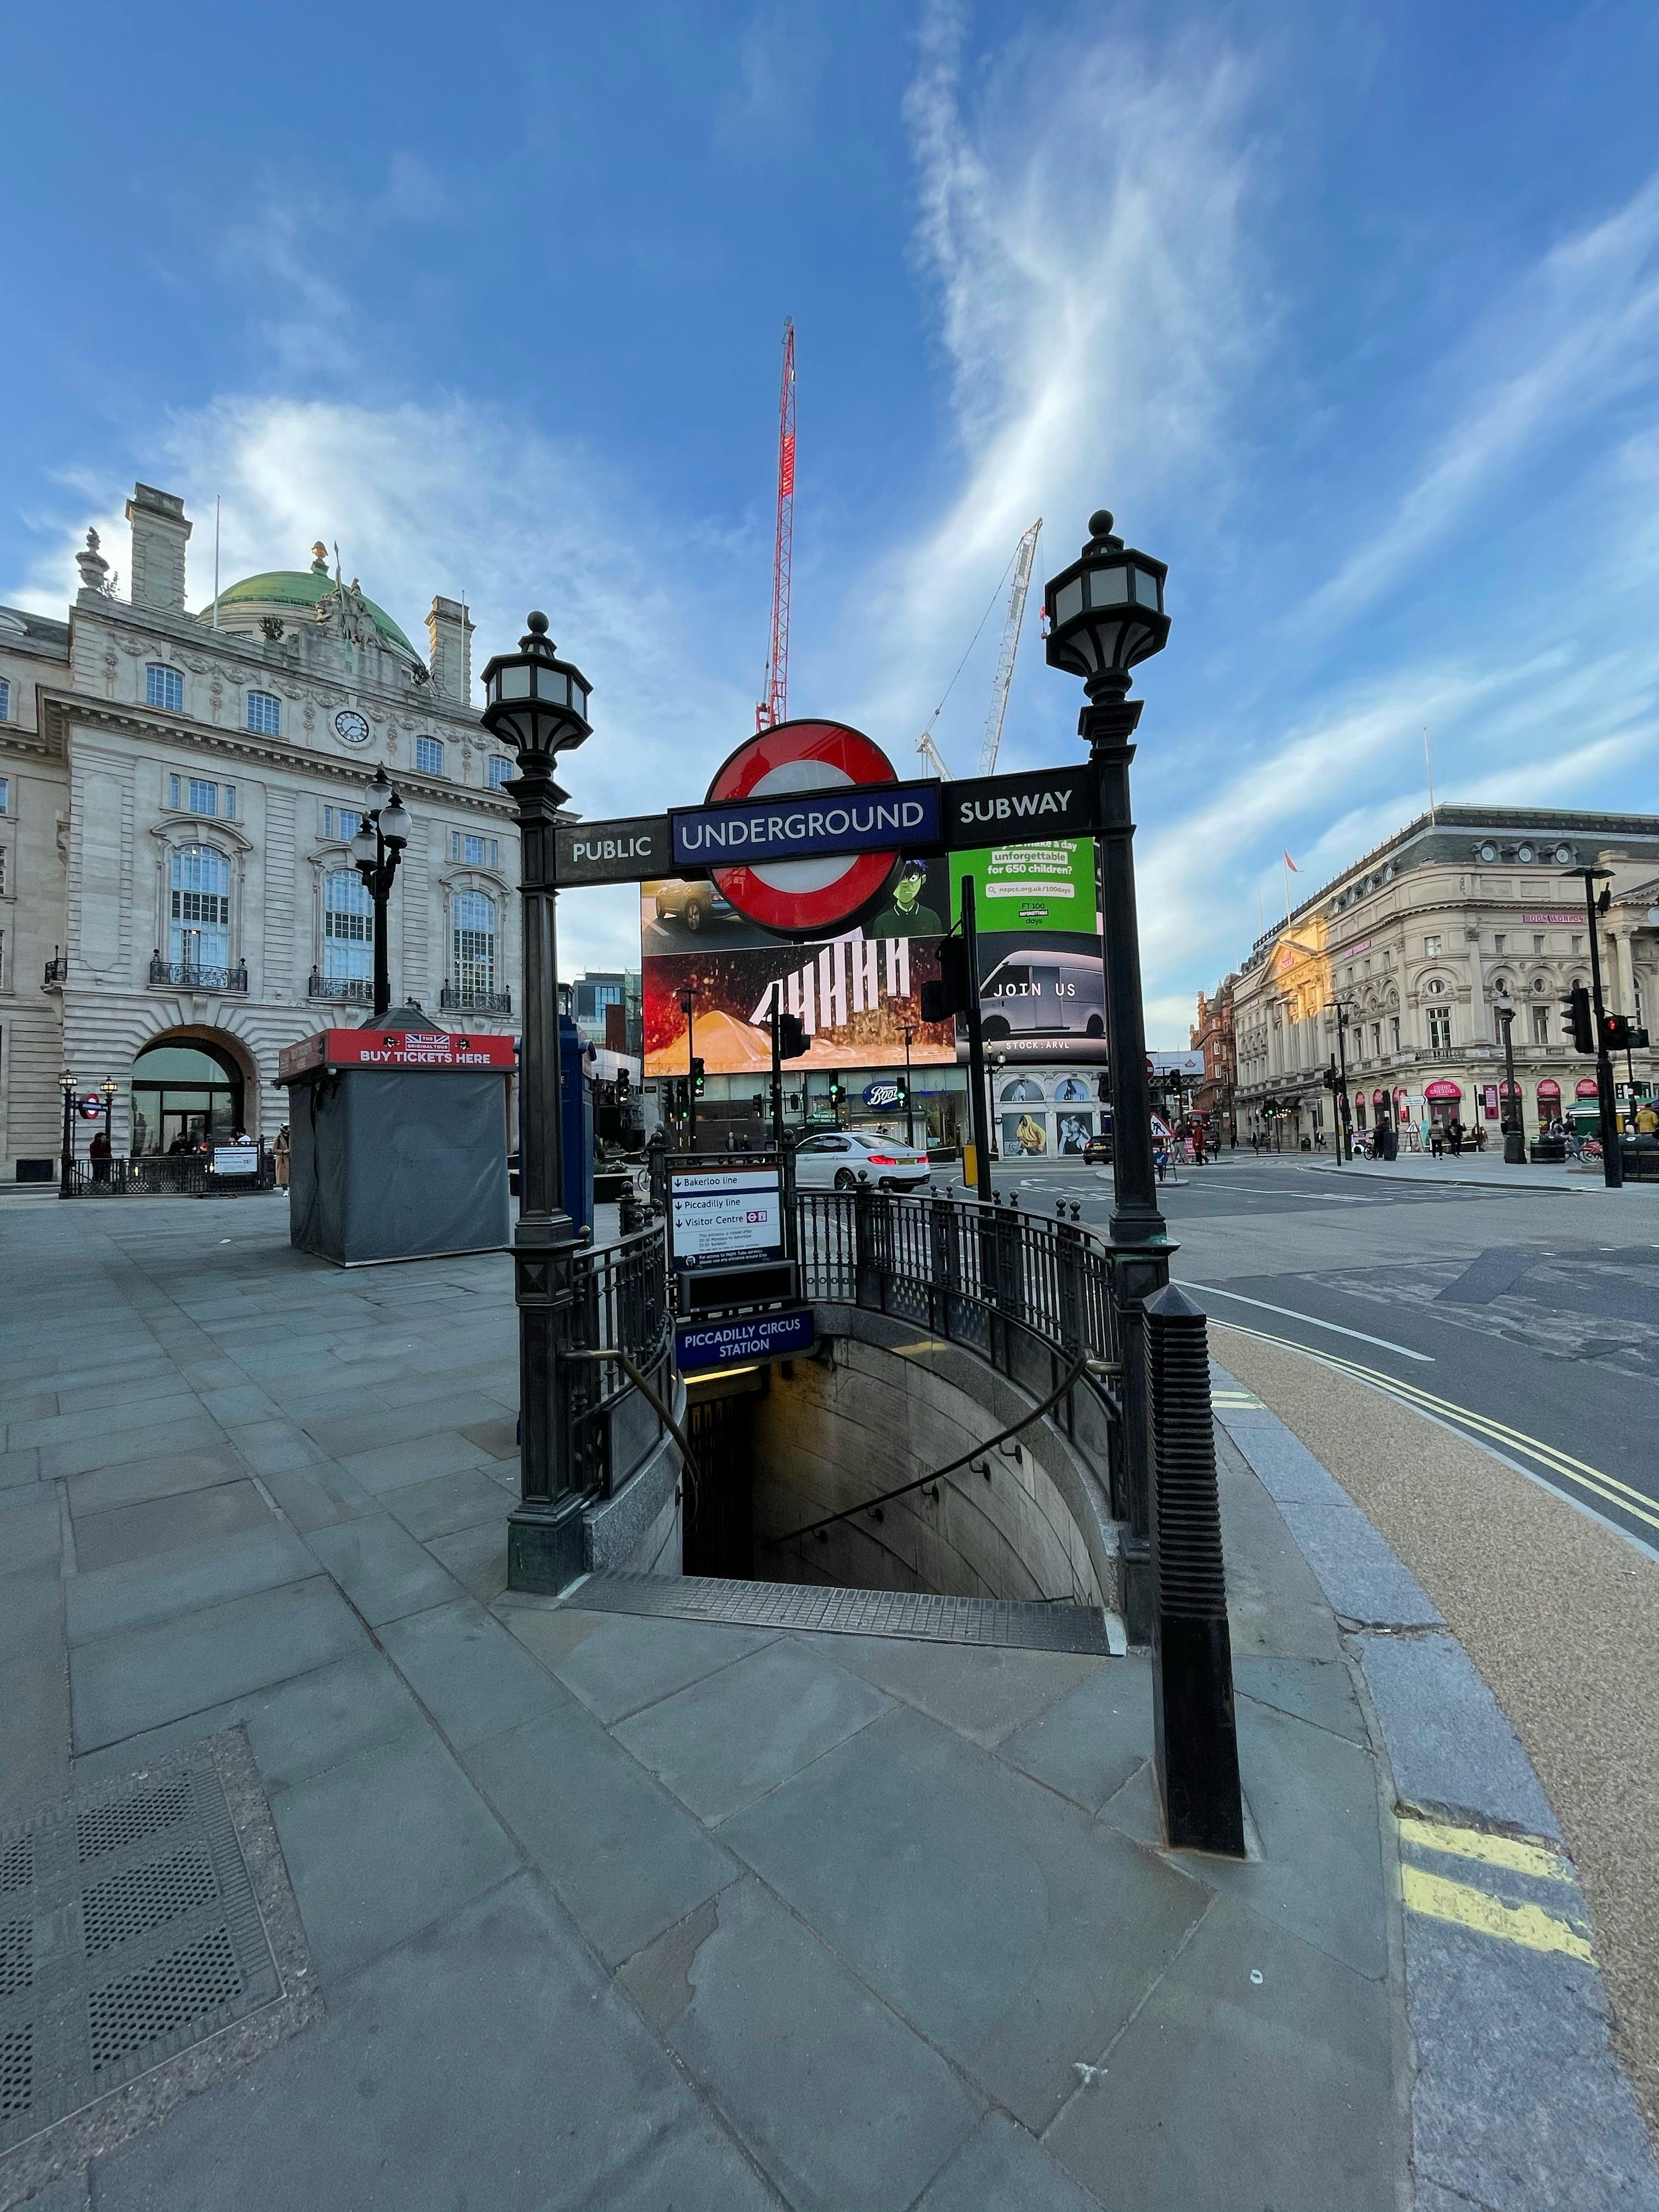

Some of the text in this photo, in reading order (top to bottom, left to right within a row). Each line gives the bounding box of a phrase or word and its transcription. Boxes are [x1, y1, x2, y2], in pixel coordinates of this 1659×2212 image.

[960, 790, 1073, 823] SUBWAY
[682, 802, 924, 850] UNDERGROUND
[573, 836, 652, 862] PUBLIC
[1061, 840, 1077, 852] day
[995, 851, 1065, 861] unforgettable
[988, 864, 1073, 874] for 650 children?
[999, 885, 1071, 894] nspcc.org.uk/100days
[994, 983, 1076, 997] JOIN US
[1006, 1041, 1070, 1050] STOCK:ARVL
[360, 1050, 490, 1064] BUY TICKETS HERE
[867, 1086, 899, 1105] Boot
[684, 1177, 720, 1186] Bakerloo
[685, 1198, 741, 1209] Piccadilly line
[685, 1216, 743, 1227] Visitor Centre
[685, 1318, 800, 1348] PICCADILLY CIRCUS
[719, 1338, 770, 1357] STATION
